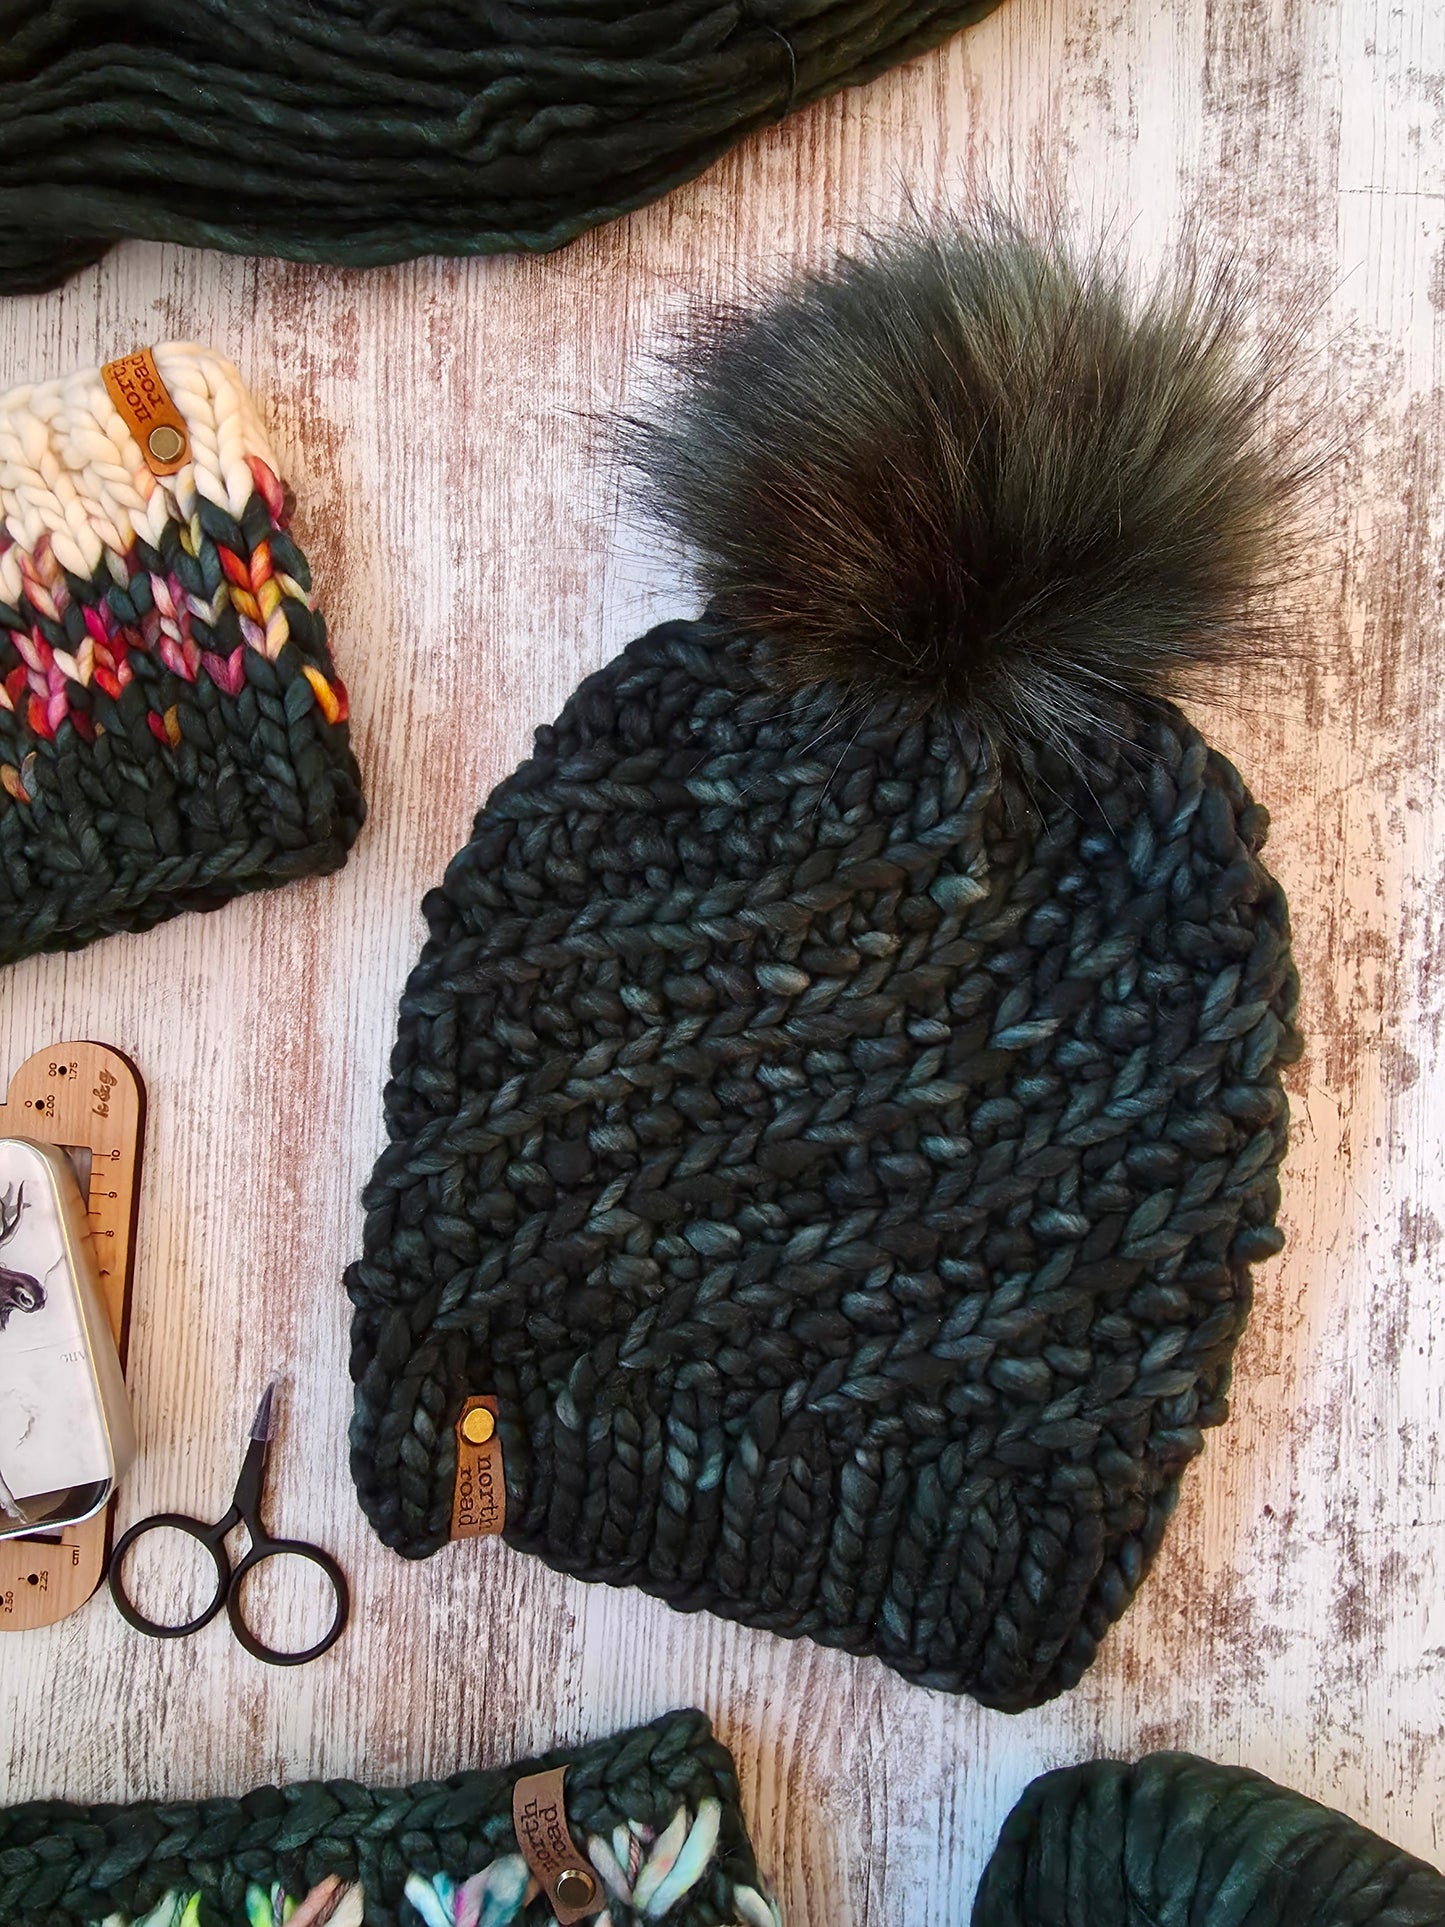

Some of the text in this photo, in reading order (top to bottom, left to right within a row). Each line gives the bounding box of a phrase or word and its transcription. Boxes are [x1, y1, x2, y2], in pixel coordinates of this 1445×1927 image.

[69, 1062, 78, 1080] 1.75
[46, 1095, 55, 1118] 2.00
[111, 1149, 120, 1161] 10
[108, 1191, 118, 1199] 9
[458, 1466, 478, 1528] road
[478, 1454, 499, 1531] north
[72, 1549, 79, 1566] cm
[40, 1570, 49, 1592] 2.25
[4, 1590, 14, 1614] 2.50
